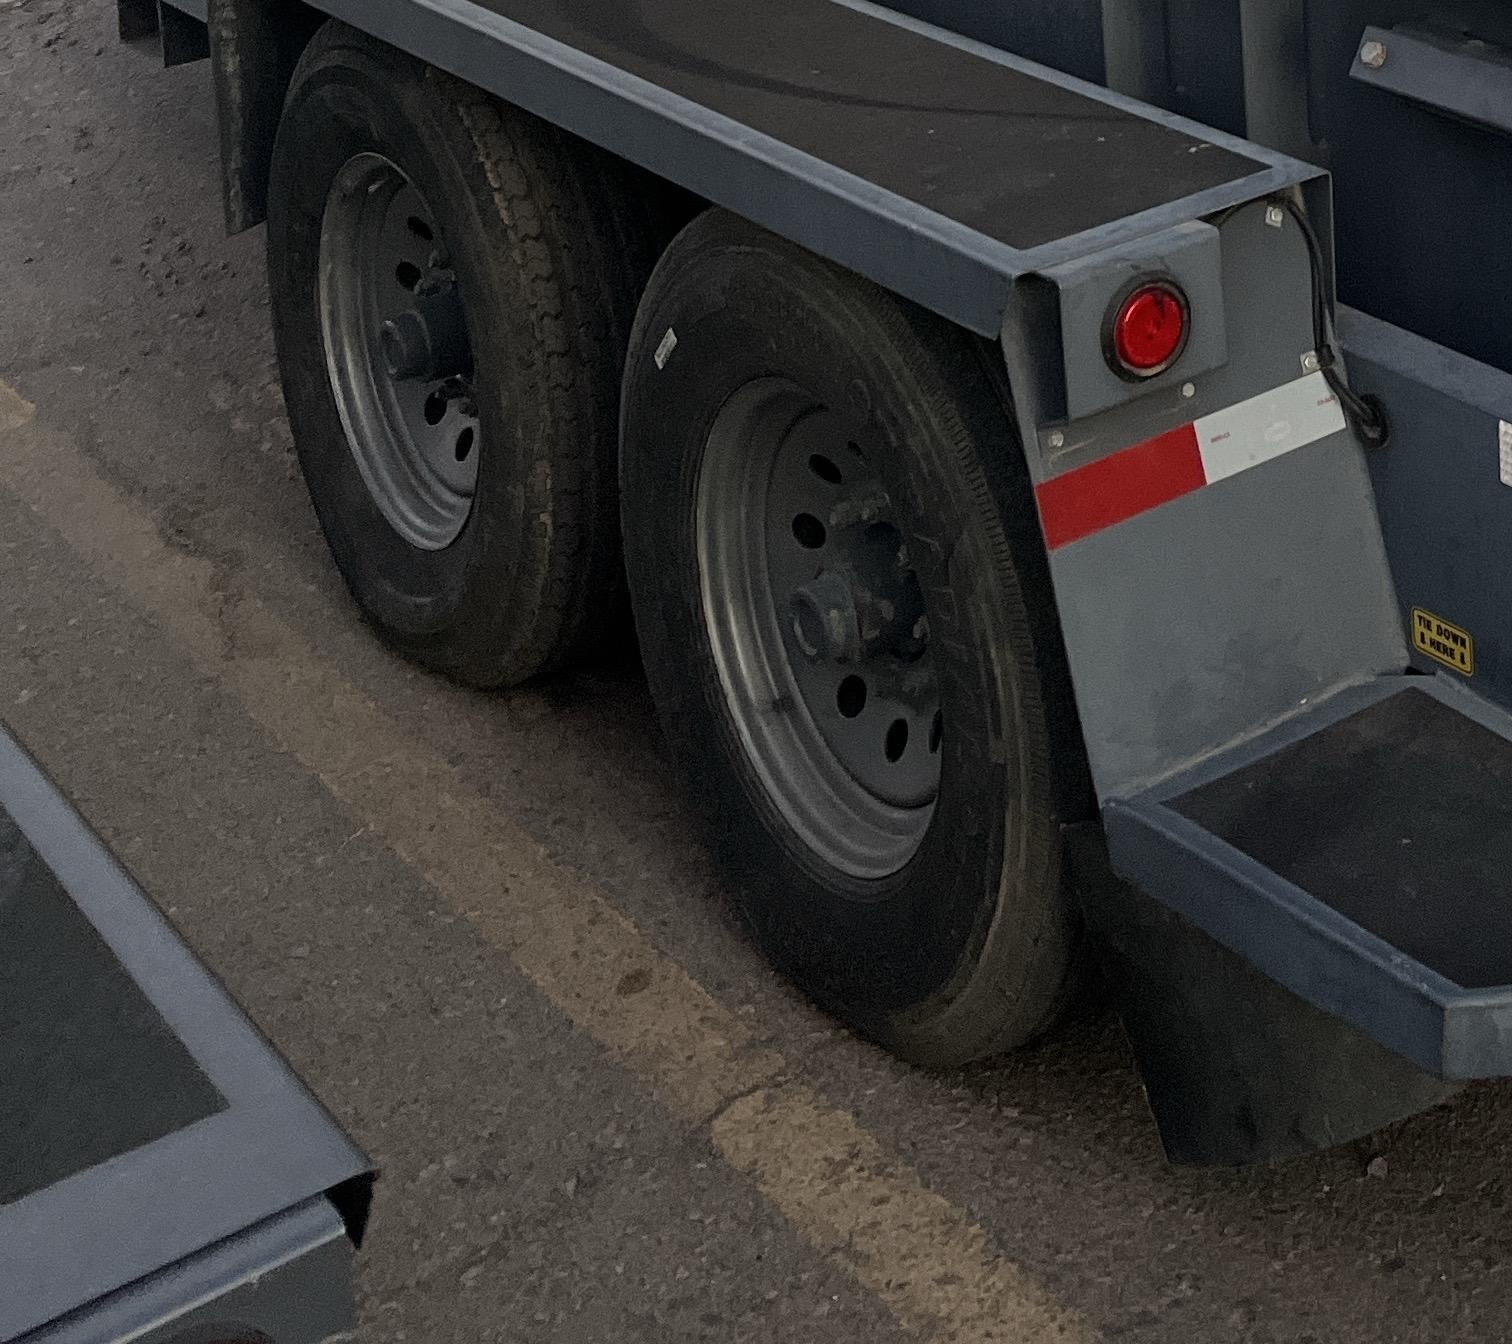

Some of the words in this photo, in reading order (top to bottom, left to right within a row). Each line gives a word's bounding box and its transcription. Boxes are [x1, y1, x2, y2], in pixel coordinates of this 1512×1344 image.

[1417, 614, 1433, 632] TIE
[1435, 623, 1467, 650] DOWN
[1429, 637, 1456, 661] HERE
